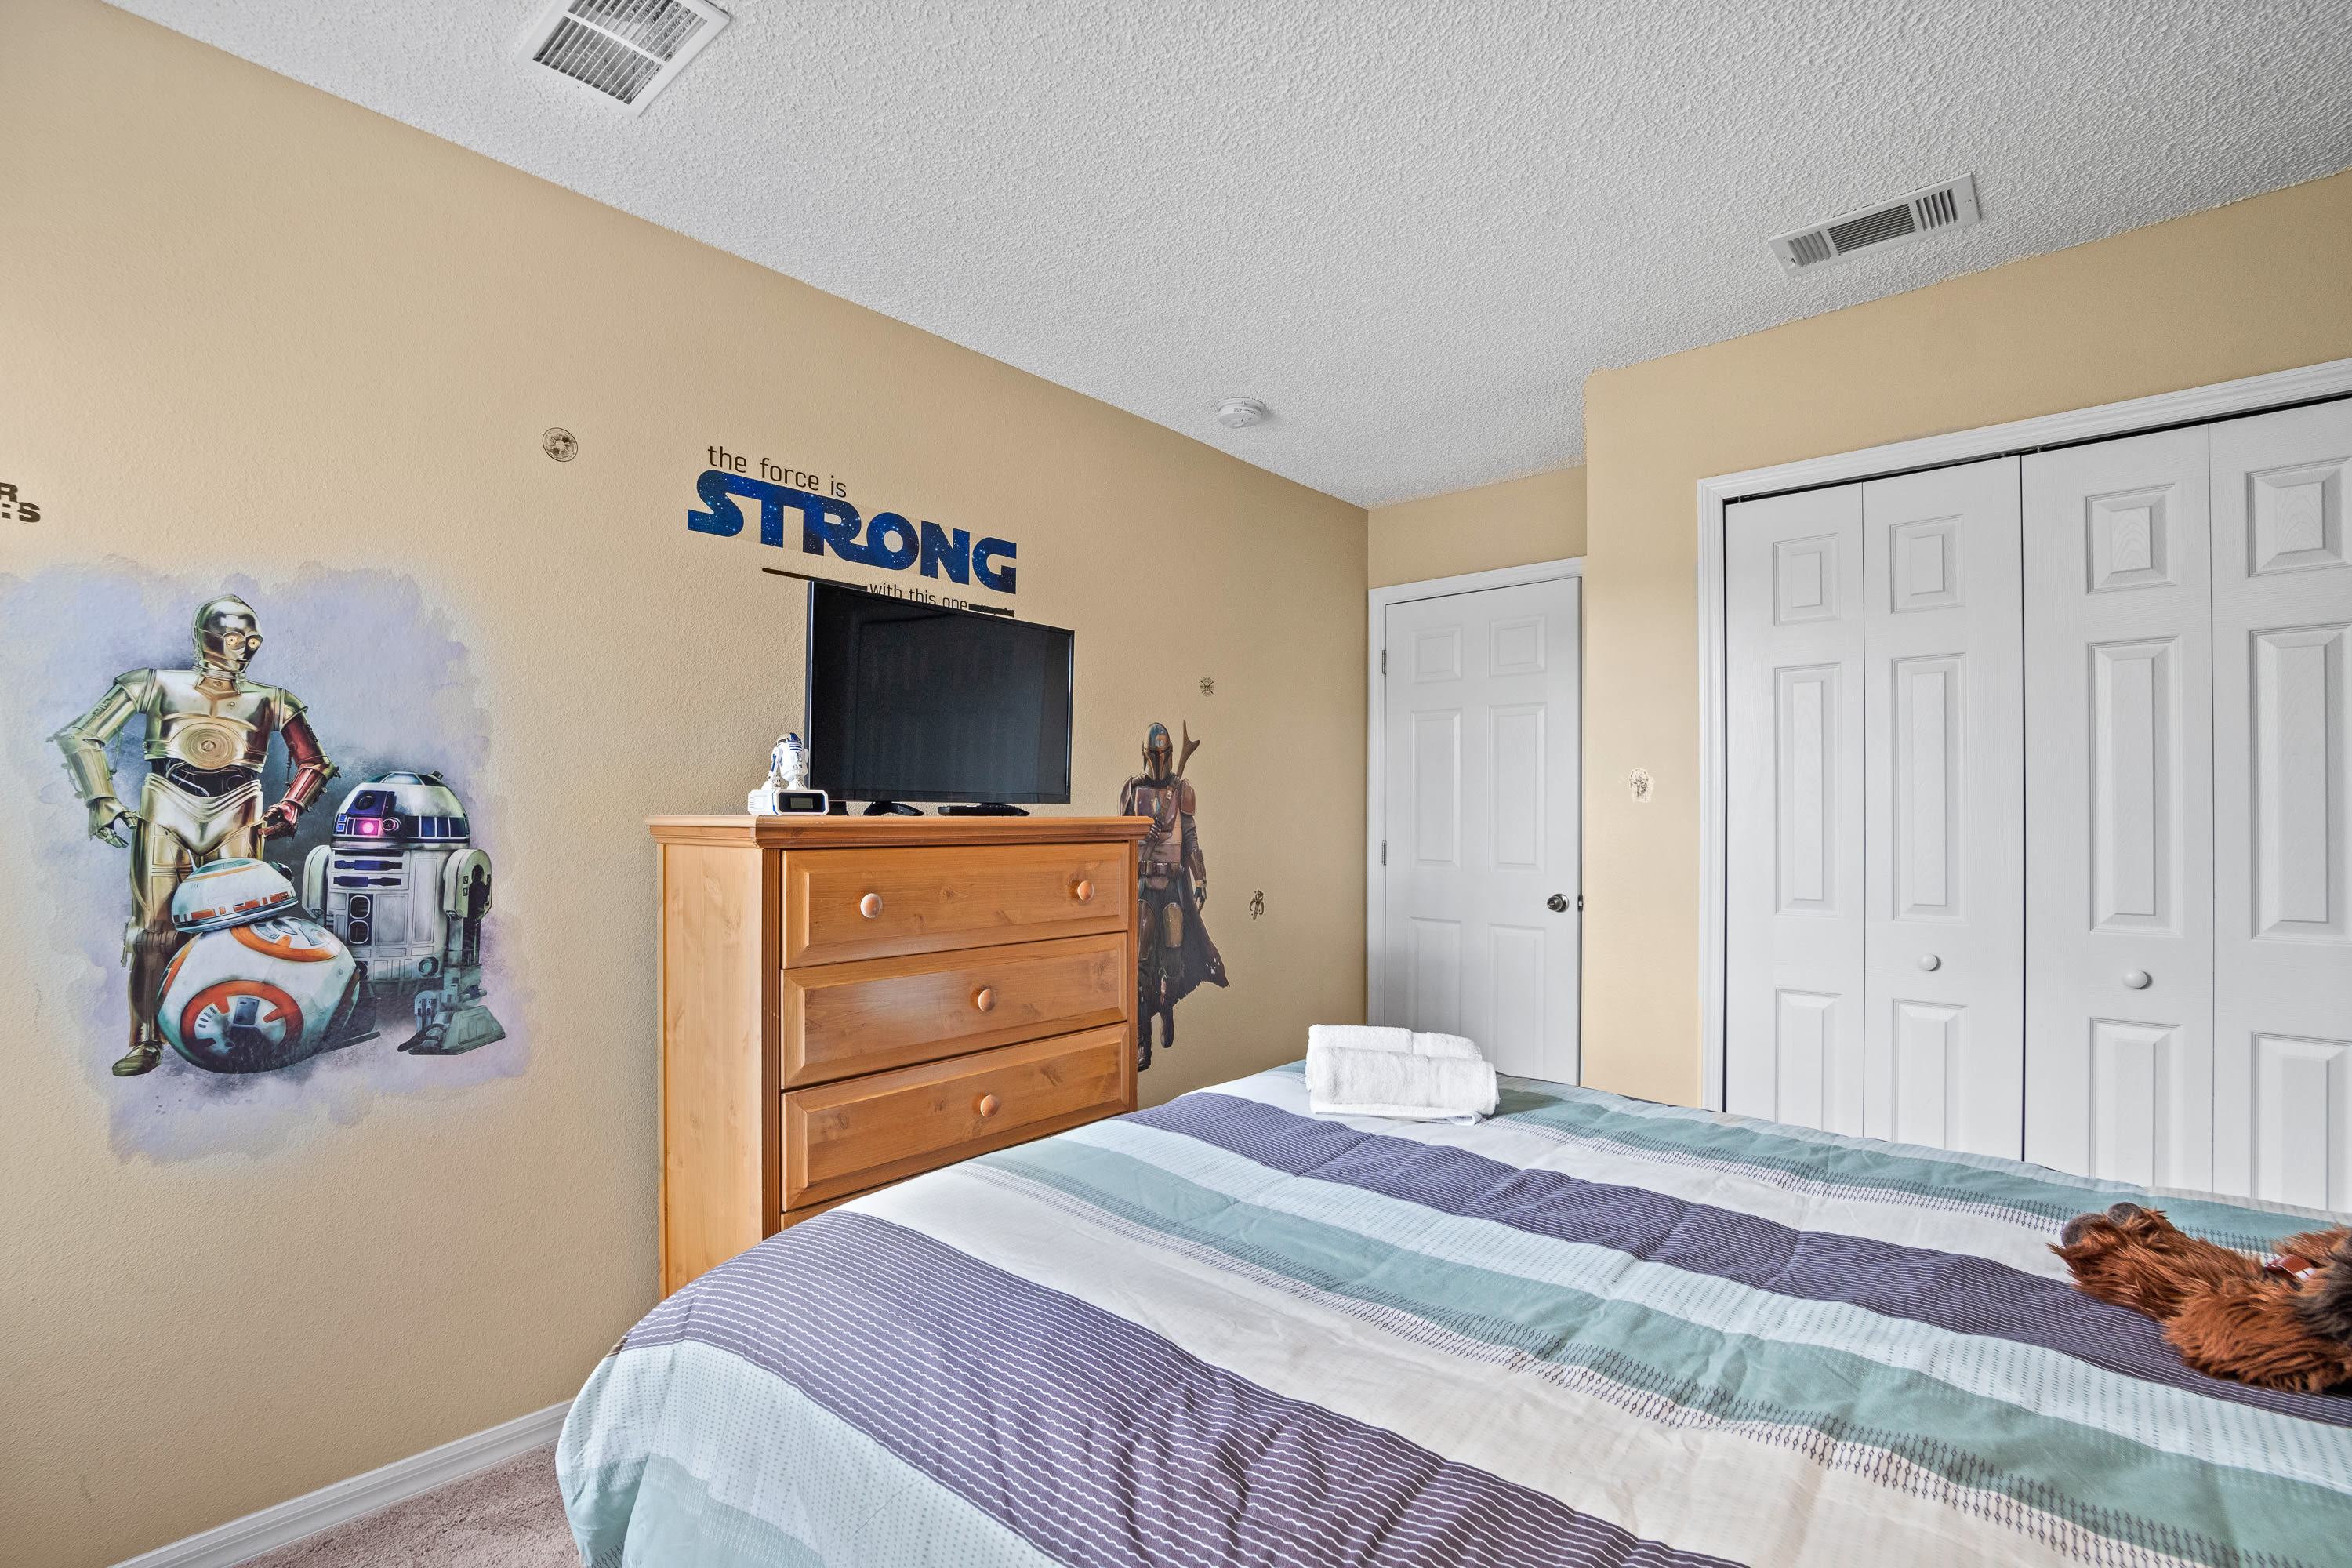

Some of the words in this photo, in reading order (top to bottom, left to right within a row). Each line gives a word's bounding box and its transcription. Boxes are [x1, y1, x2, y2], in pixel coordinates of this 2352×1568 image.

[707, 445, 747, 473] the
[760, 457, 819, 491] force
[830, 474, 848, 498] is
[688, 469, 1017, 595] STRONG
[869, 582, 902, 598] with
[909, 588, 936, 605] this
[942, 597, 967, 610] one
